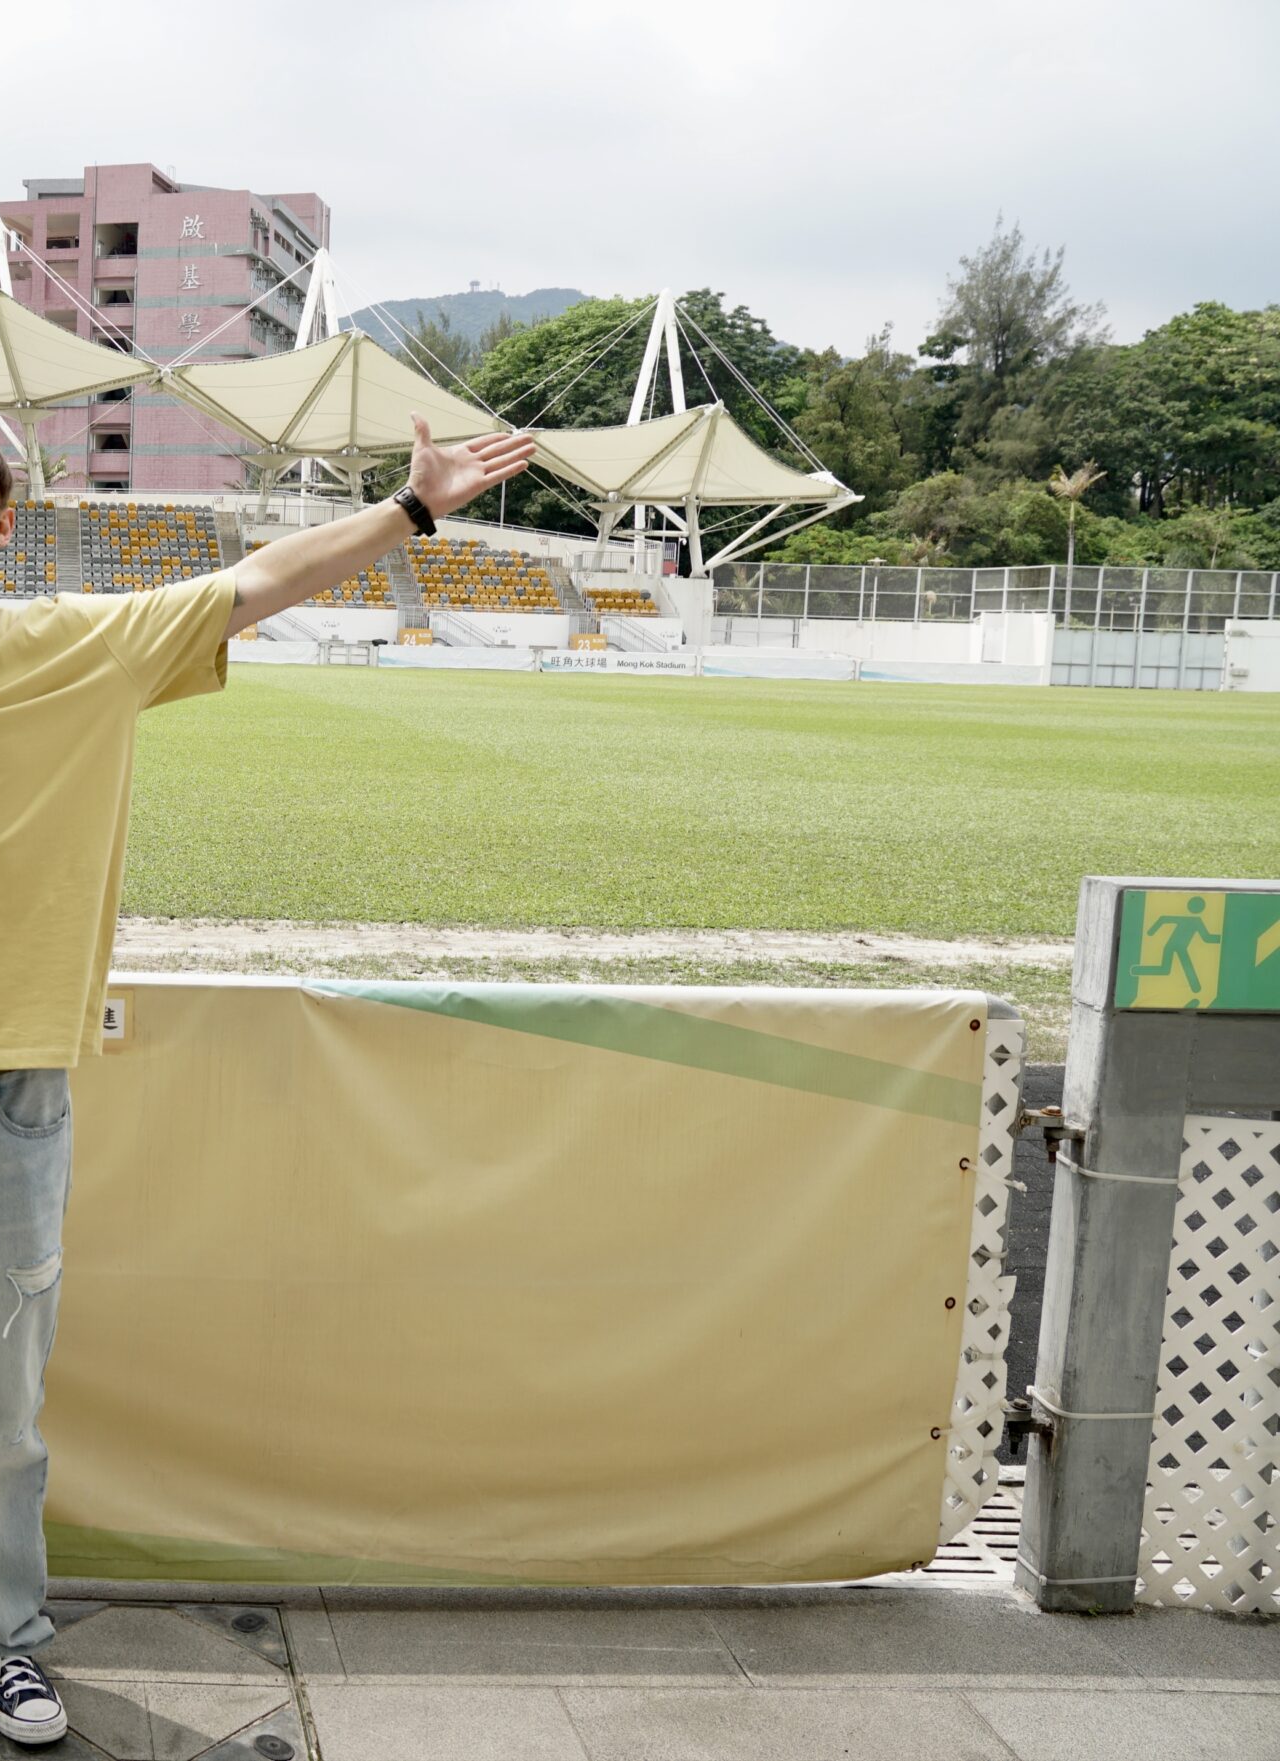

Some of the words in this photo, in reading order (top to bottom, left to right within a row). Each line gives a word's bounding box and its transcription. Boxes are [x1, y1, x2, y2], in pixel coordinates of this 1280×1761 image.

[404, 634, 417, 646] 24
[551, 656, 607, 668] 旺角大球場
[617, 660, 638, 669] Mong
[656, 661, 686, 669] Stadium
